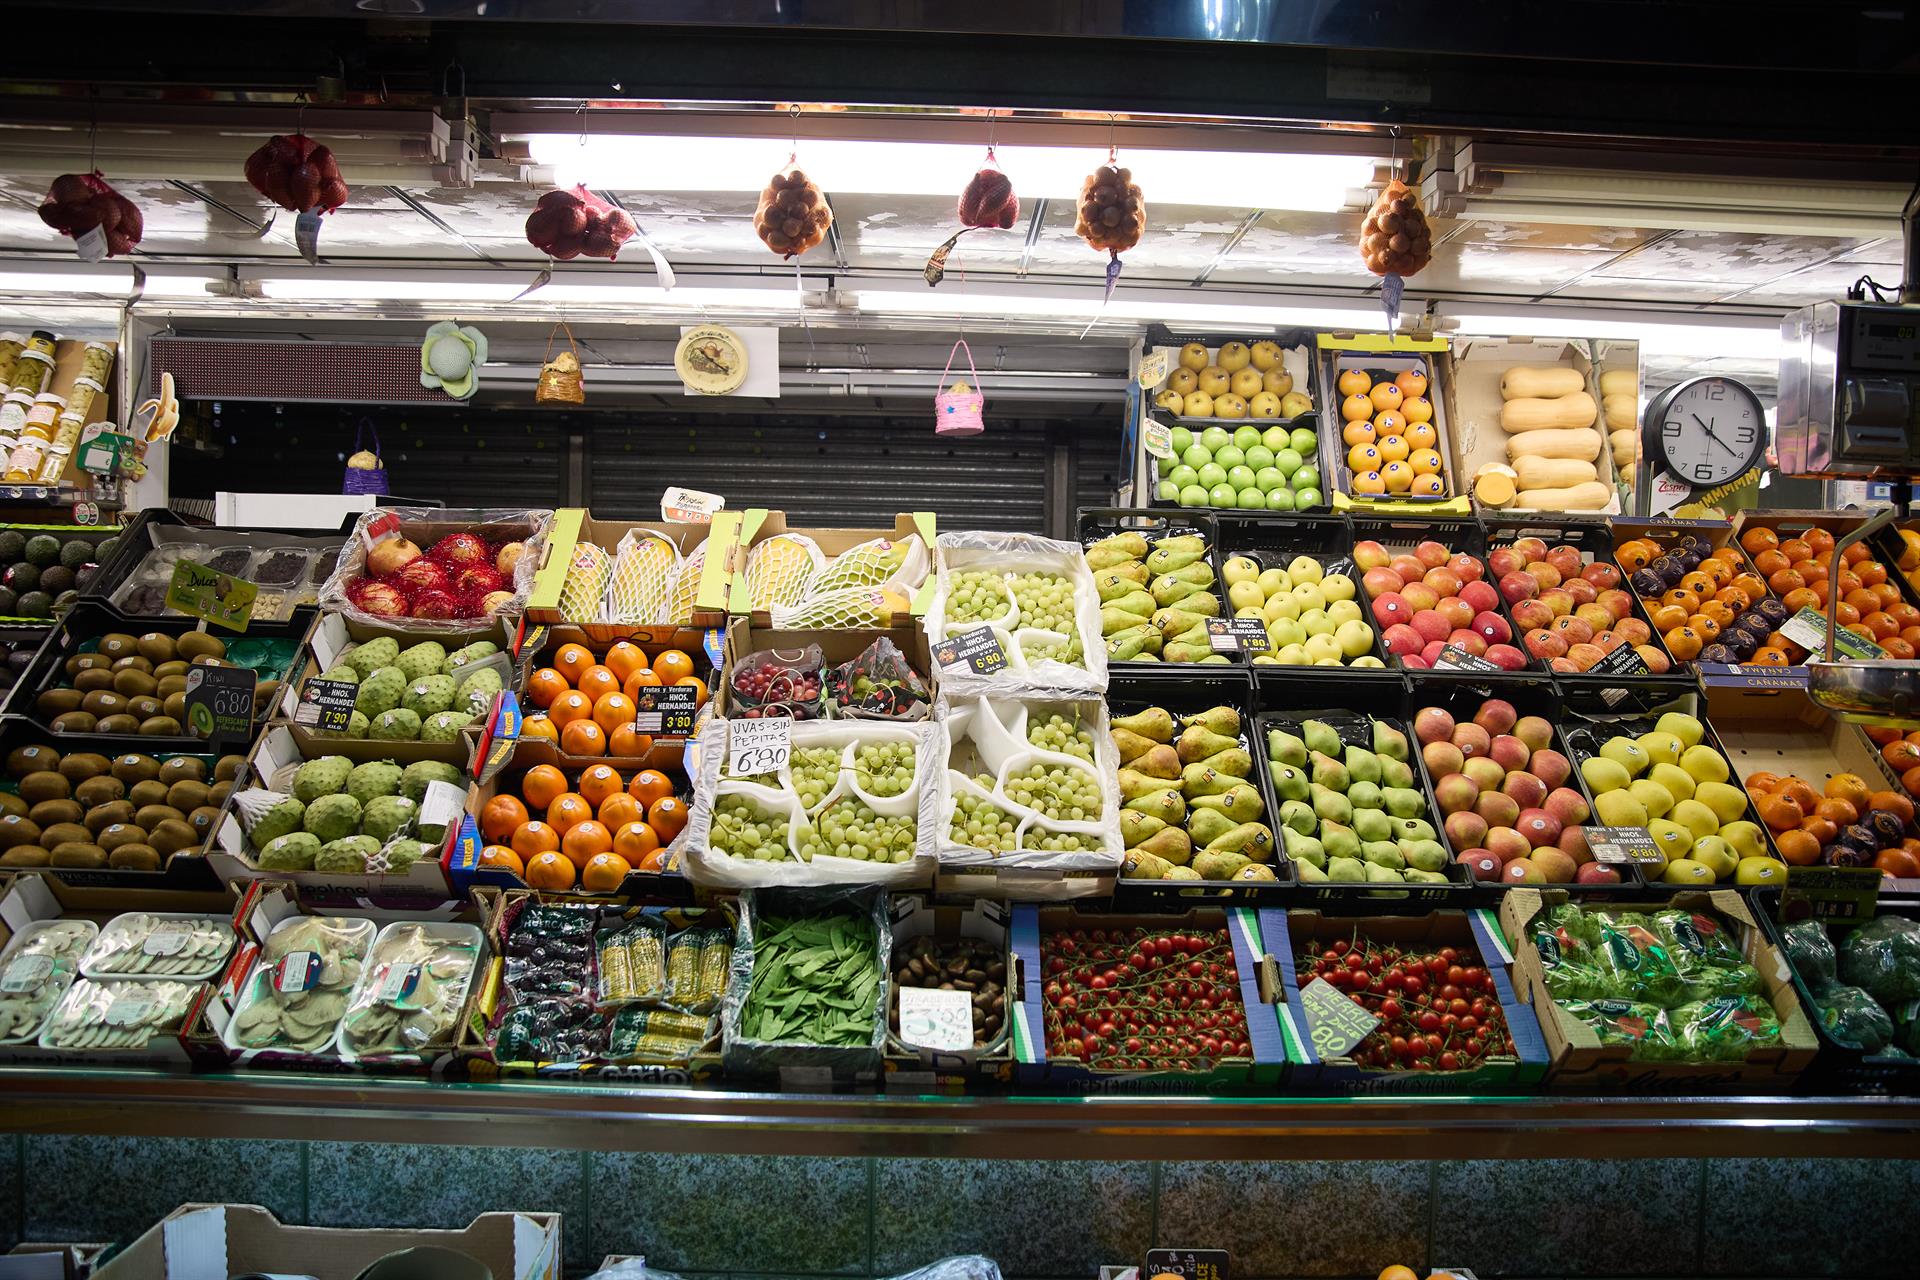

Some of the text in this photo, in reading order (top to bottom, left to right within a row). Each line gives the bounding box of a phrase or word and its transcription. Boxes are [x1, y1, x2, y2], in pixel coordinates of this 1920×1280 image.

[1690, 390, 1697, 399] 11
[1704, 384, 1725, 401] 12
[1733, 393, 1737, 401] 1
[1673, 404, 1683, 414] 10
[1742, 410, 1750, 418] 2
[1663, 421, 1682, 437] 9
[1736, 426, 1755, 443] 3
[1668, 446, 1676, 455] 8
[1737, 452, 1744, 460] 4
[1681, 463, 1688, 471] 7
[1694, 464, 1713, 480] 6
[1720, 466, 1728, 474] 5
[936, 640, 954, 650] Frutas
[961, 628, 987, 640] Verduras
[966, 635, 987, 647] HNOS.
[1242, 639, 1266, 648] 4'80
[958, 639, 998, 659] HERNANDEZ
[1607, 645, 1628, 660] Verduras
[975, 652, 1001, 668] 6'80
[1449, 646, 1466, 656] Frutas
[1474, 655, 1499, 669] Verduras
[1612, 652, 1631, 666] HNOS.
[333, 682, 355, 690] Verduras
[331, 689, 349, 698] HNOS.
[215, 690, 250, 714] 6'80
[319, 697, 355, 707] HERNANDEZ
[657, 702, 696, 710] HERNANDEZ
[325, 711, 347, 725] 7'90
[667, 716, 691, 728] 3'80
[732, 732, 787, 747] PEPITAS
[737, 748, 787, 772] 6'80
[1629, 848, 1657, 858] 3'80
[1313, 983, 1378, 1030] CHERRIS
